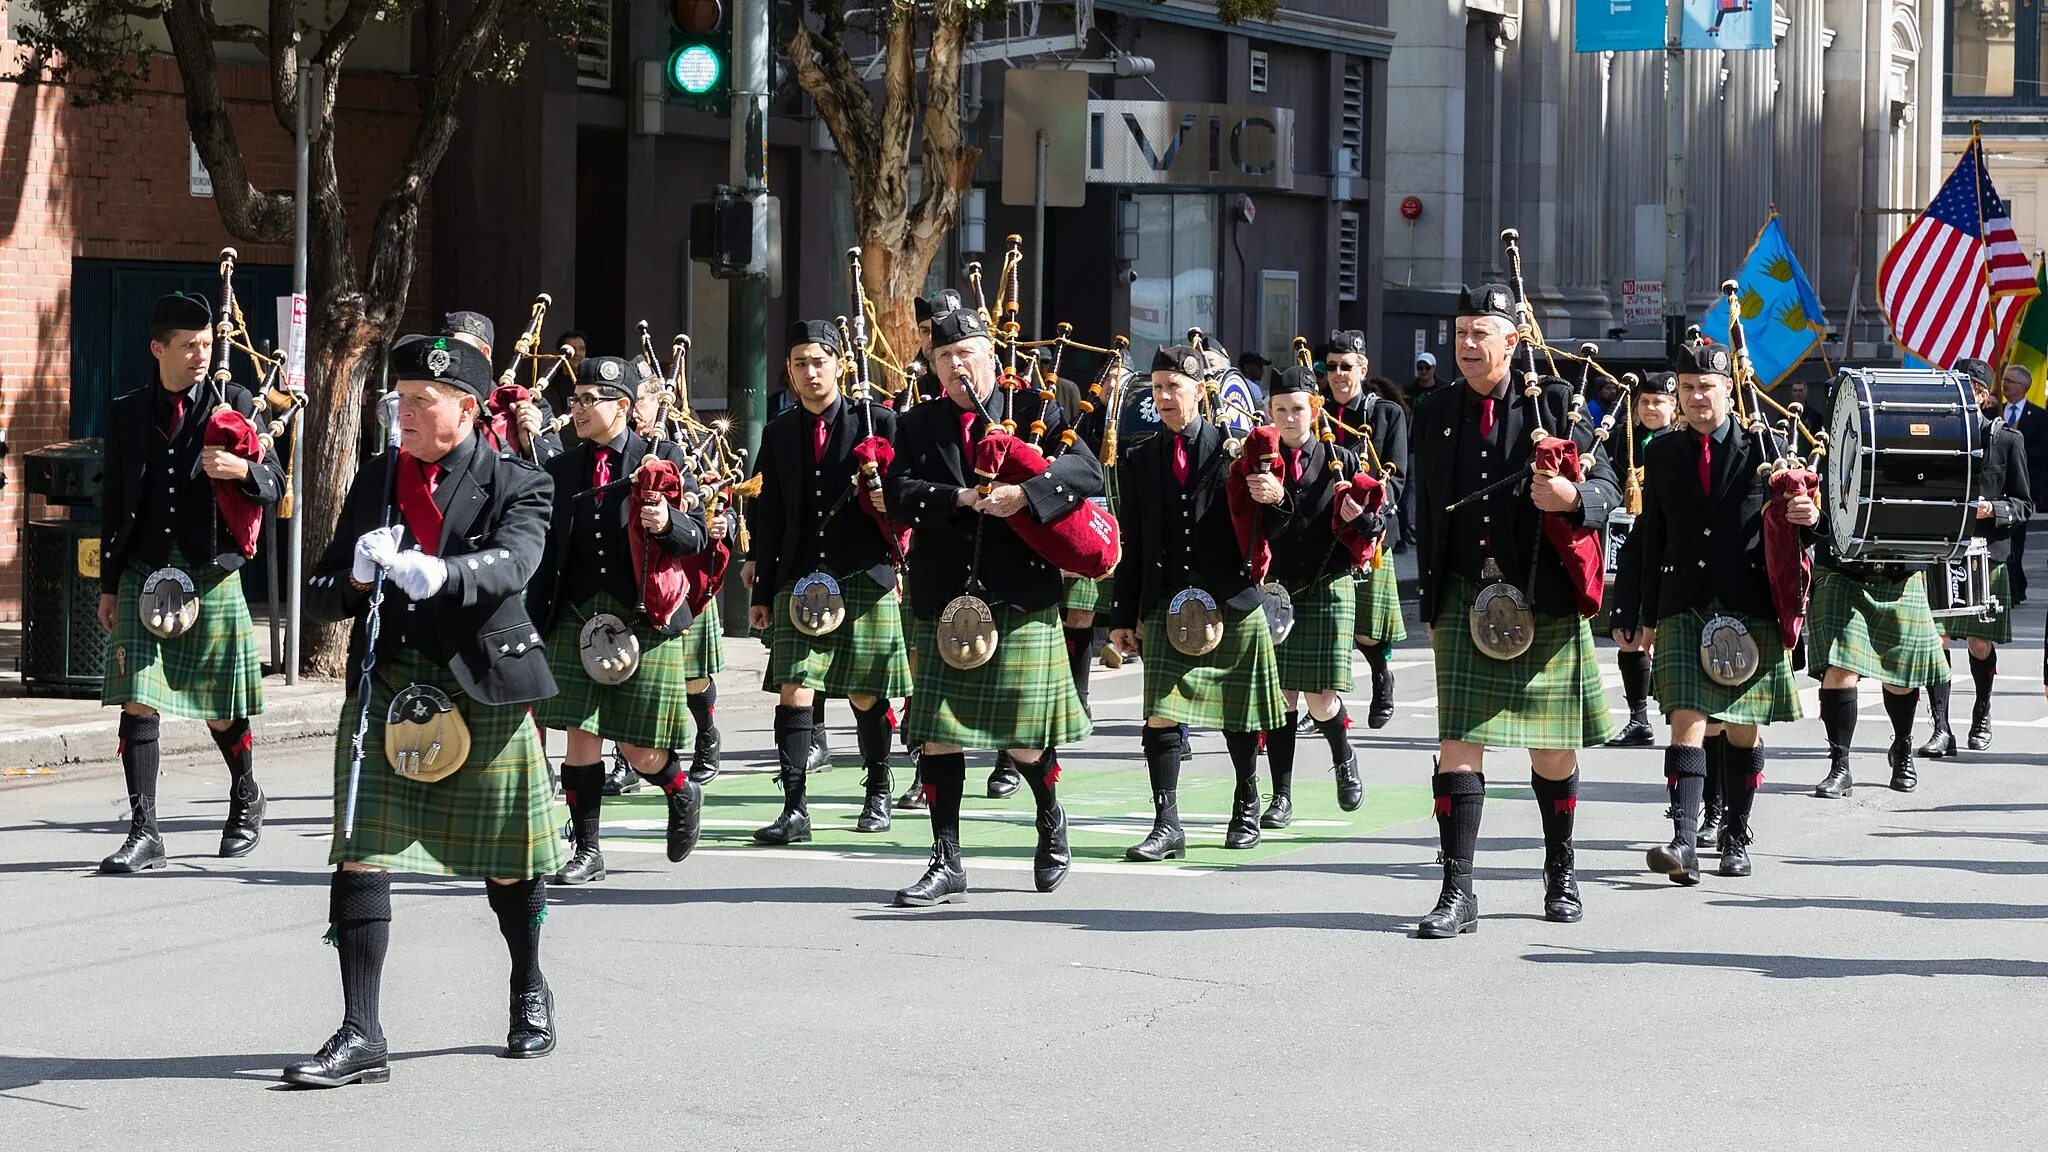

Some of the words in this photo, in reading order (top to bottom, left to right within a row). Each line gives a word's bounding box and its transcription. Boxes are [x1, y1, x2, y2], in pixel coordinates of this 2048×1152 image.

[1623, 281, 1634, 294] NO
[1636, 284, 1661, 293] PARKING
[1949, 566, 1967, 605] Pearl
